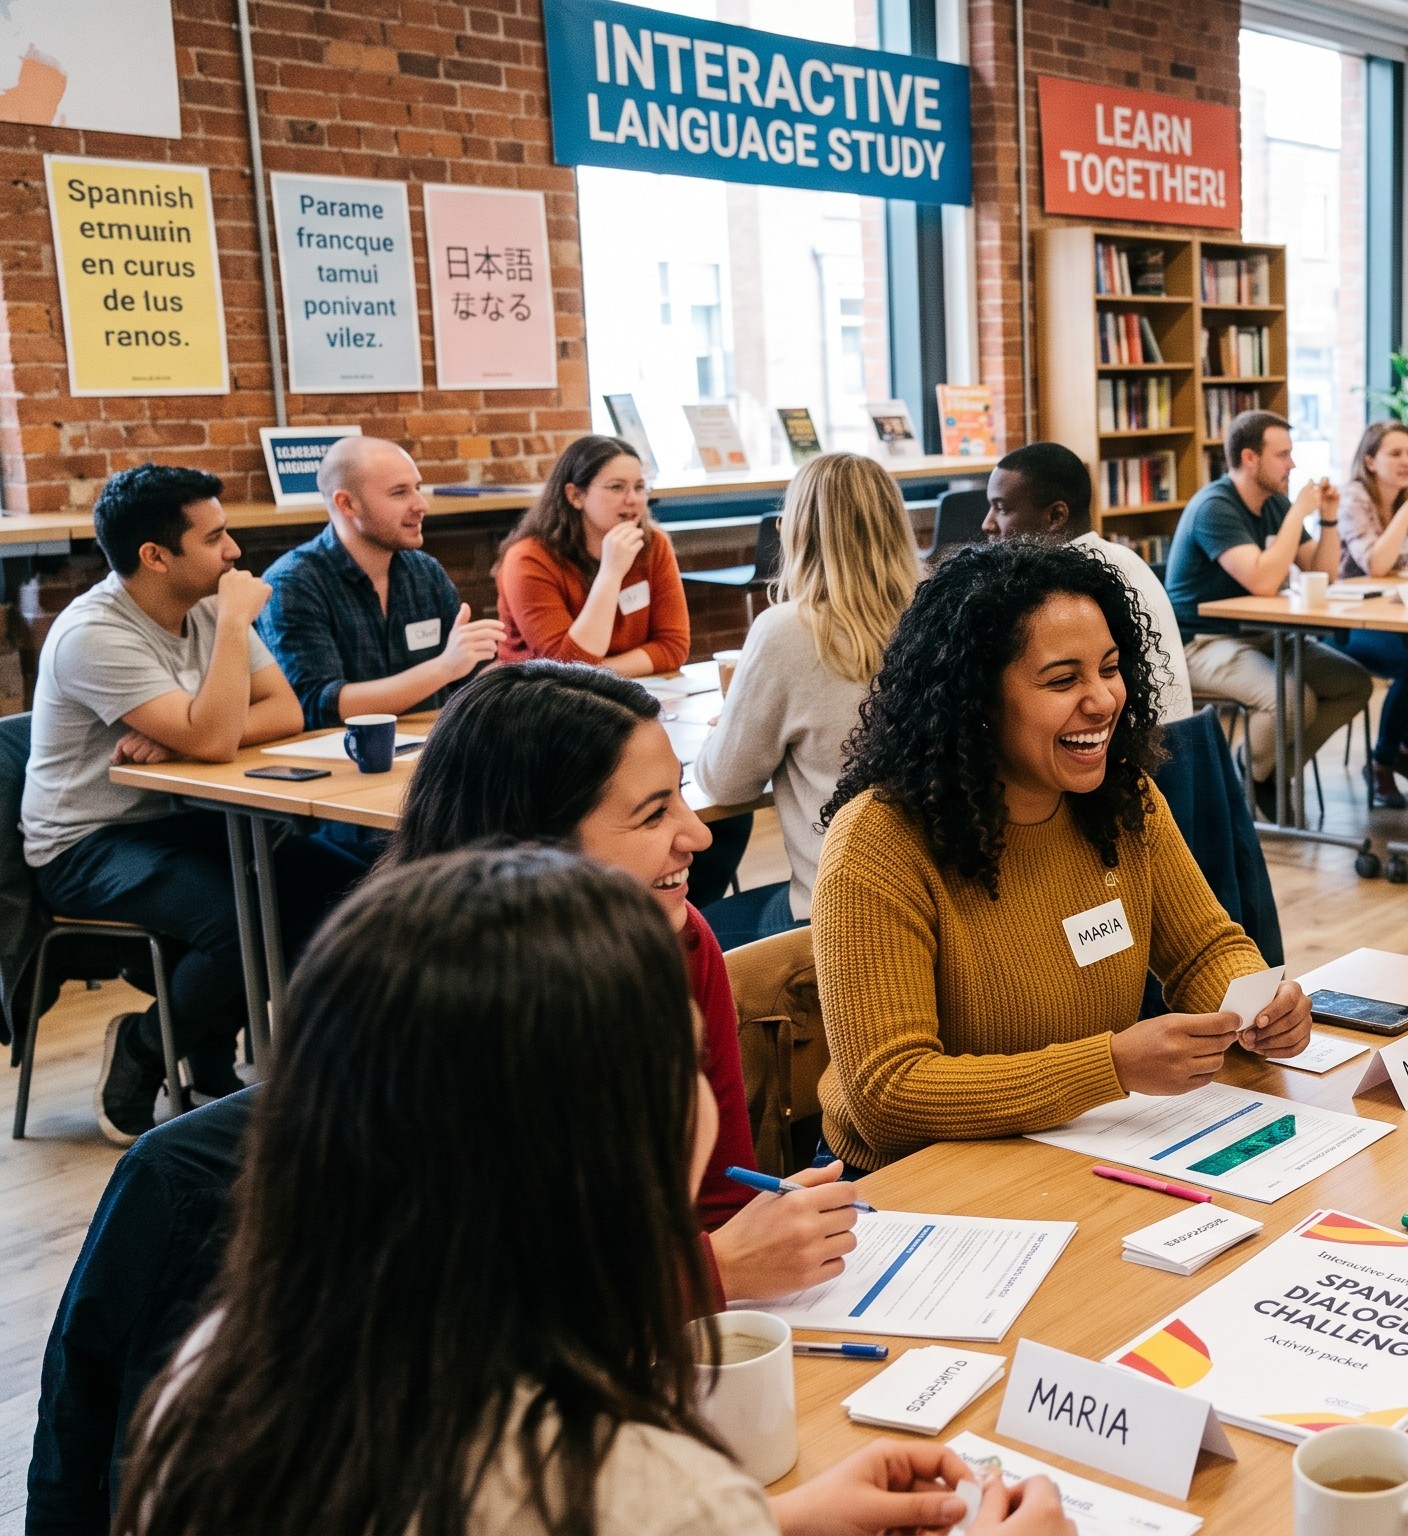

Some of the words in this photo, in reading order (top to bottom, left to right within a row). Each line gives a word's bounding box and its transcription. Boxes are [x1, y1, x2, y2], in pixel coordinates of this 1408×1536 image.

[593, 20, 942, 132] INTERACTIVE
[587, 92, 819, 168] LANGUAGE
[827, 127, 945, 181] STUDY
[1096, 102, 1192, 157] LEARN
[1060, 150, 1226, 208] TOGETHER!
[68, 179, 194, 209] Spannish
[299, 194, 384, 219] Parame
[296, 227, 394, 255] francque
[81, 257, 115, 275] en
[124, 259, 196, 278] curus
[317, 264, 378, 284] tamui
[446, 246, 532, 281] 日本語
[103, 288, 136, 312] de
[304, 297, 397, 320] ponivant
[326, 327, 383, 348] vilez.
[1078, 918, 1123, 946] MARIA
[1317, 1351, 1369, 1371] packet
[1028, 1377, 1129, 1446] MARIA
